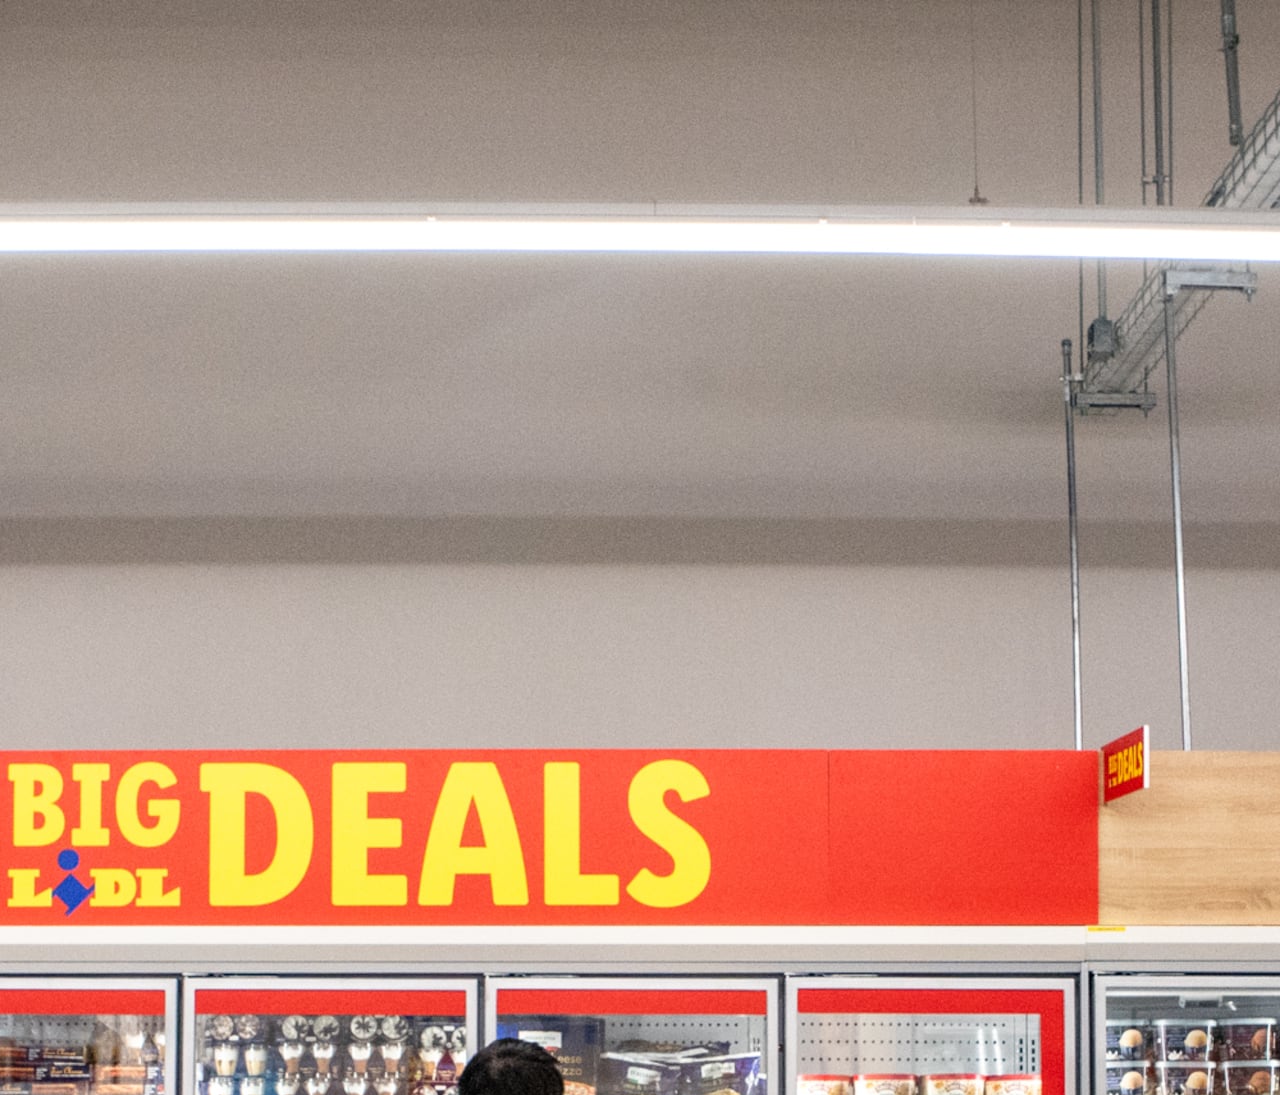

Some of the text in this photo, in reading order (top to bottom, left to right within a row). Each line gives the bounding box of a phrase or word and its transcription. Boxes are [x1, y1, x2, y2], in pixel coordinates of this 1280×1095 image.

[8, 762, 181, 848] BIG
[1118, 741, 1143, 784] DEALS
[199, 759, 711, 908] DEALS
